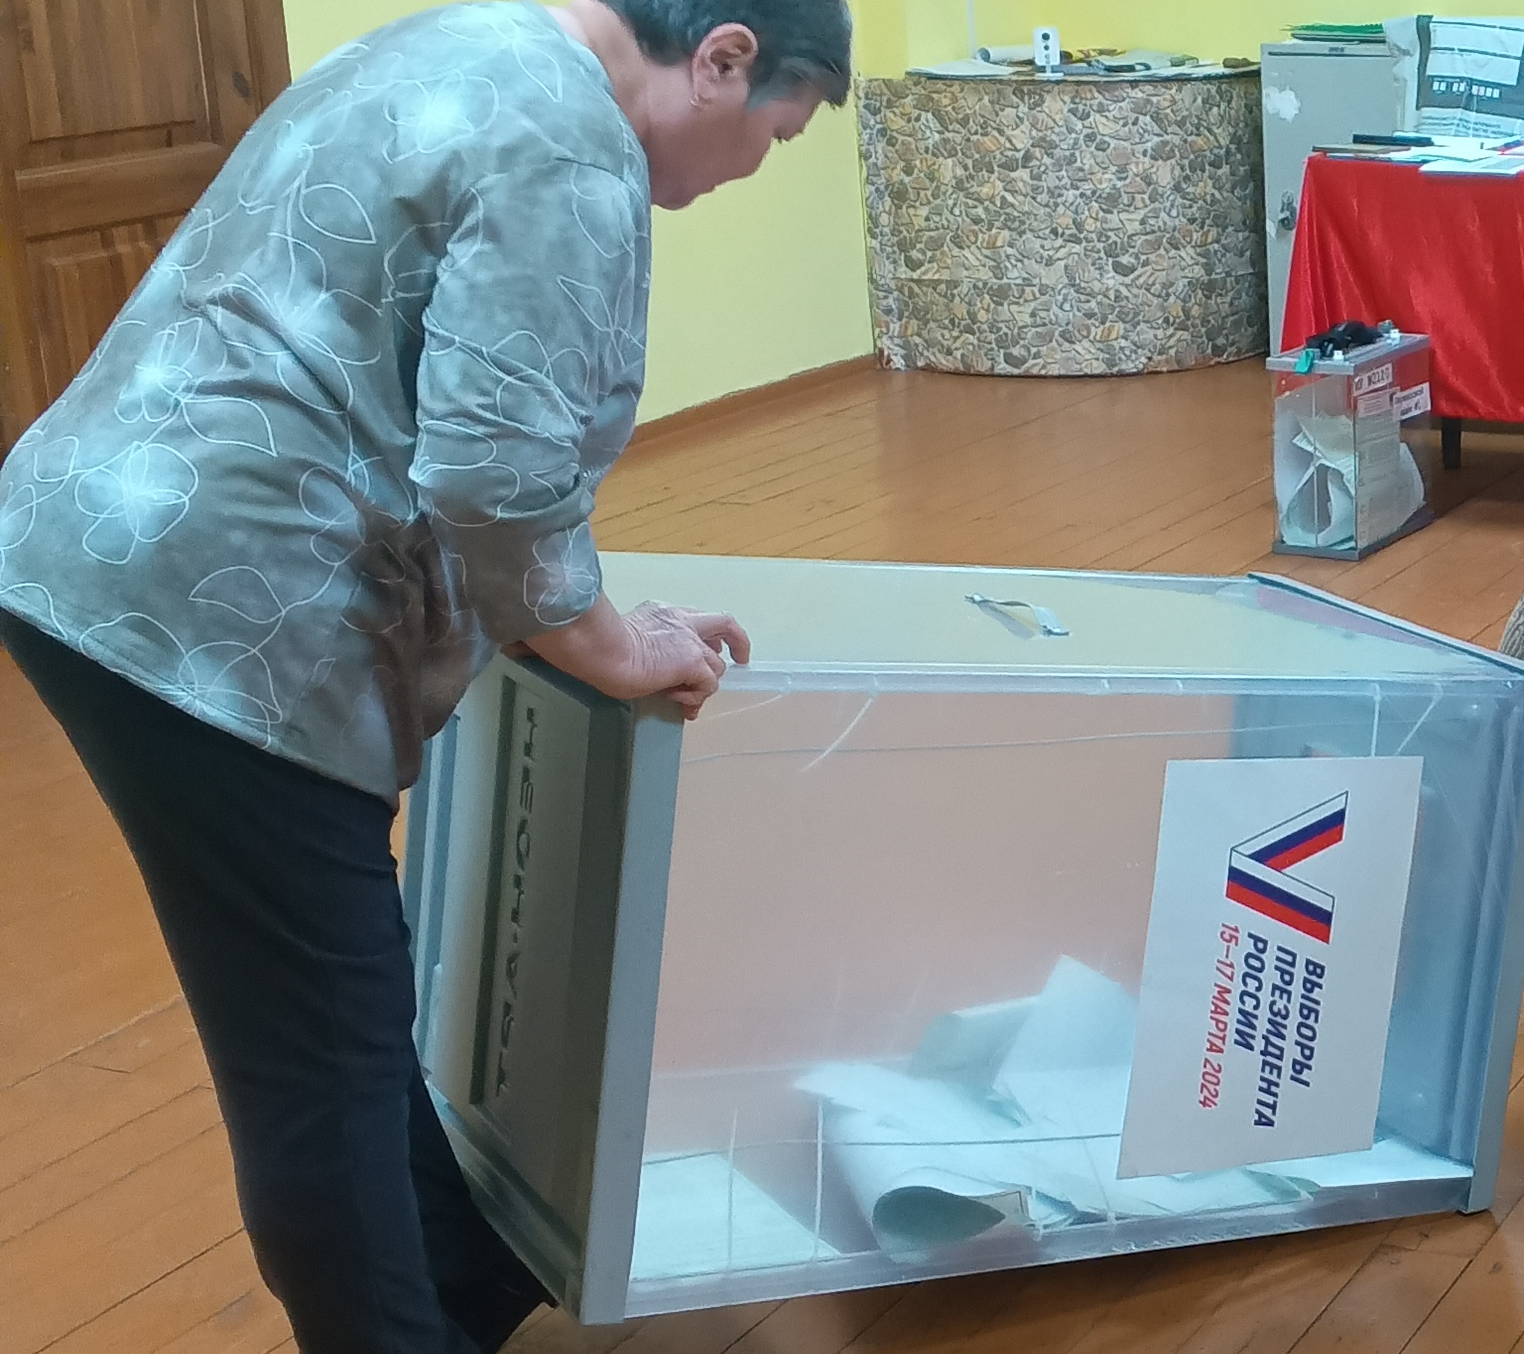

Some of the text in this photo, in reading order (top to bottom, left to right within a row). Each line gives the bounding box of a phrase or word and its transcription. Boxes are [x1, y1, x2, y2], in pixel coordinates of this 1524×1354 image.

[1207, 983, 1233, 1053] МАРТА
[1233, 931, 1269, 1053] РОССИИ
[1254, 944, 1298, 1128] ПРЕЗИДЕНТА
[1290, 957, 1326, 1088] ВЫБОРЫ
[1198, 1058, 1225, 1109] 2024
